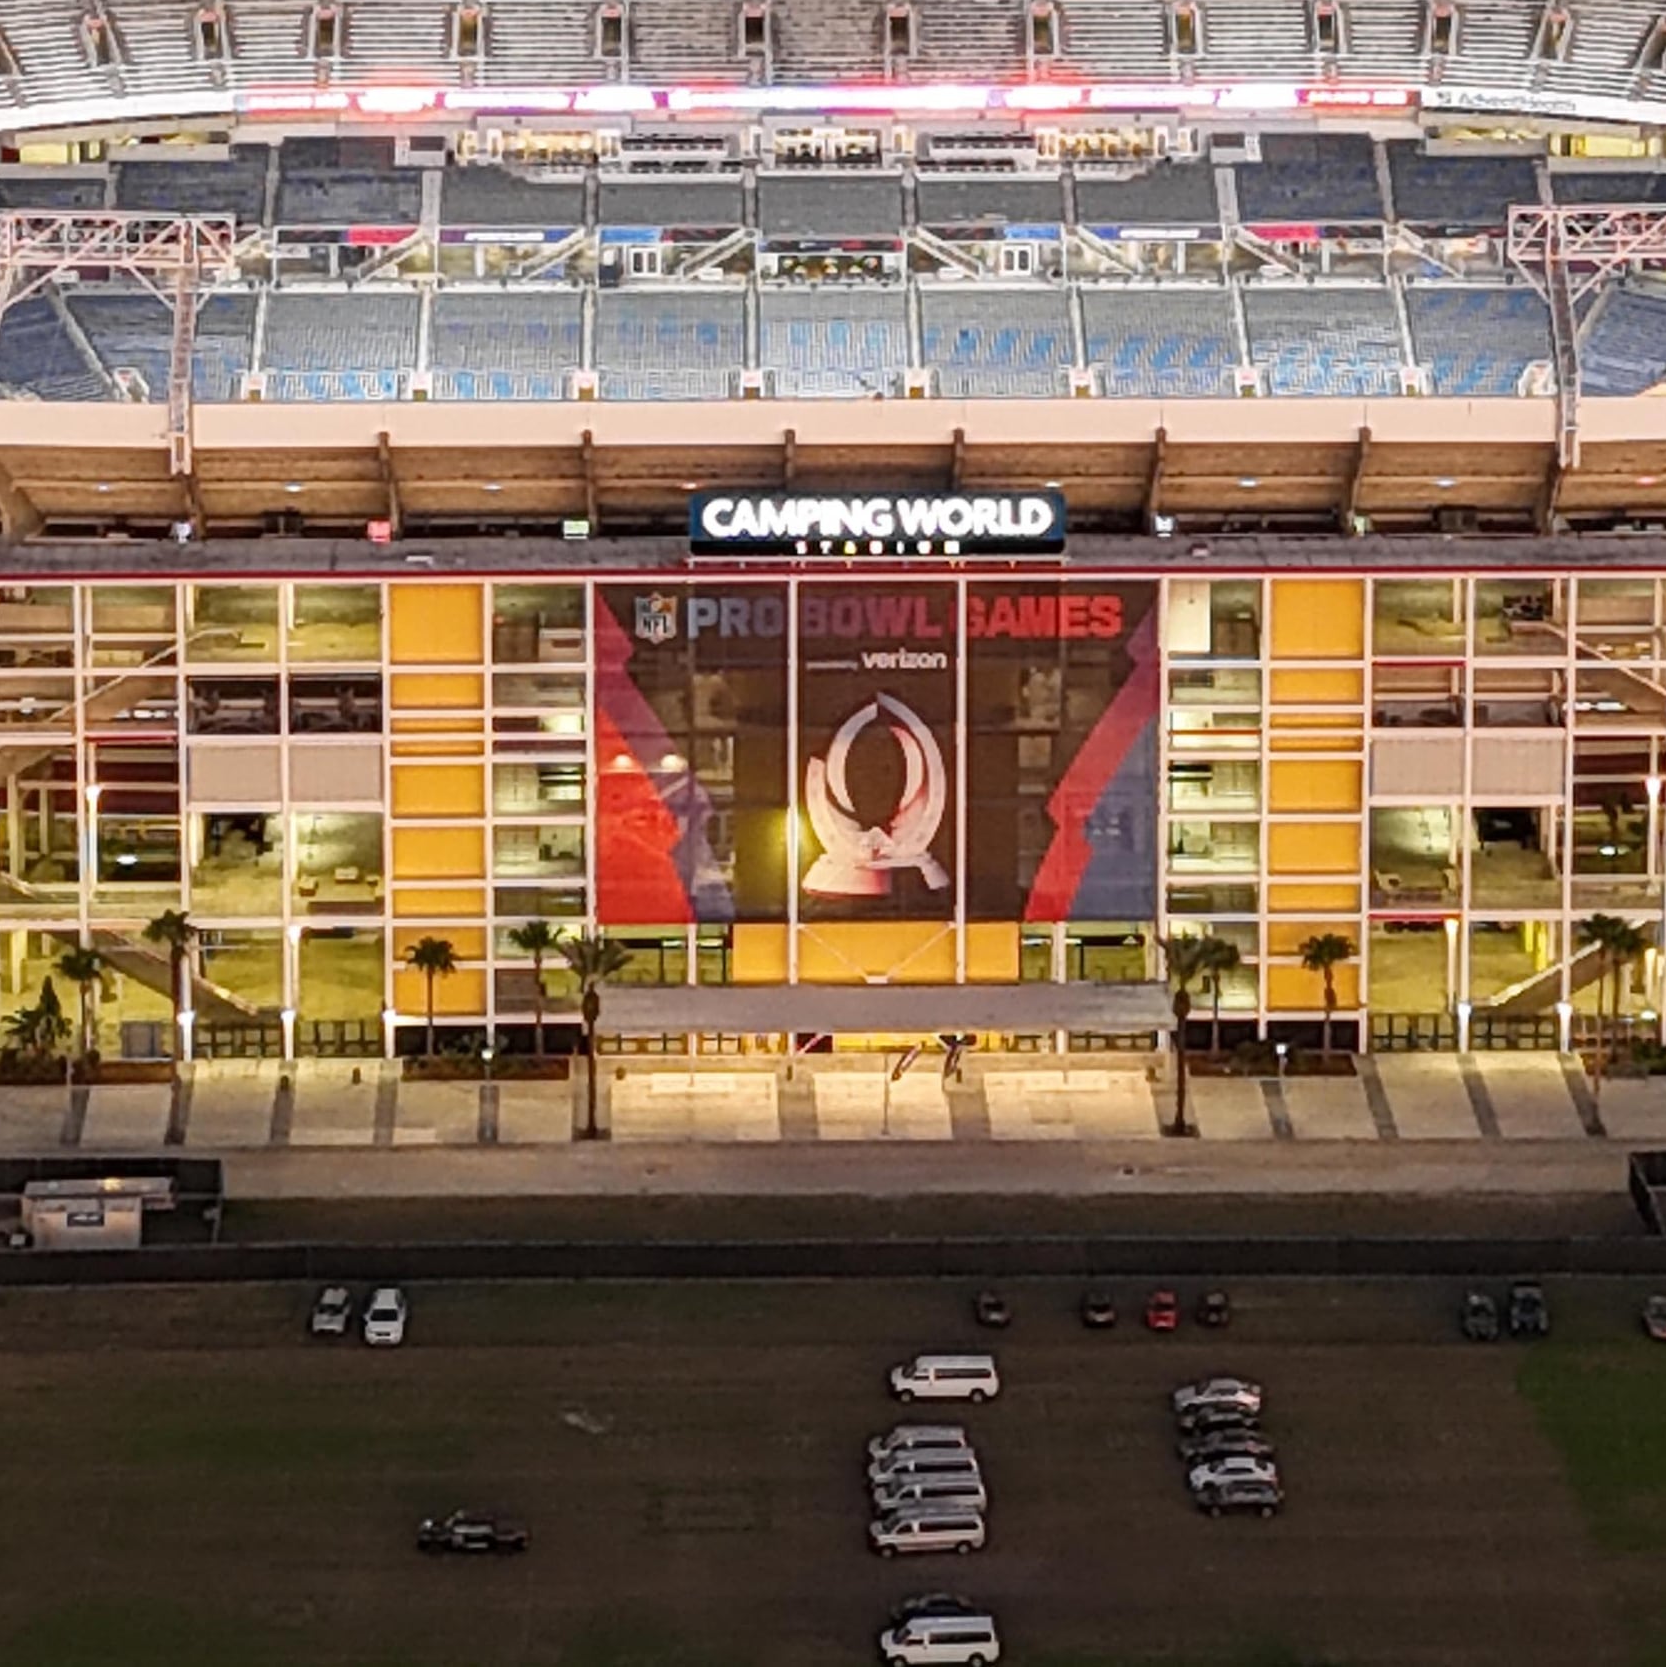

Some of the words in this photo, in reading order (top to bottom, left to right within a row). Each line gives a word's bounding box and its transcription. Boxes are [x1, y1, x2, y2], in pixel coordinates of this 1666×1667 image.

[702, 498, 892, 537] CAMPING
[895, 498, 1054, 537] WORLD
[642, 618, 671, 635] NFL
[687, 598, 782, 638] PRO
[801, 597, 943, 638] BOWL
[950, 595, 1123, 638] GAMES
[862, 648, 947, 669] verizon
